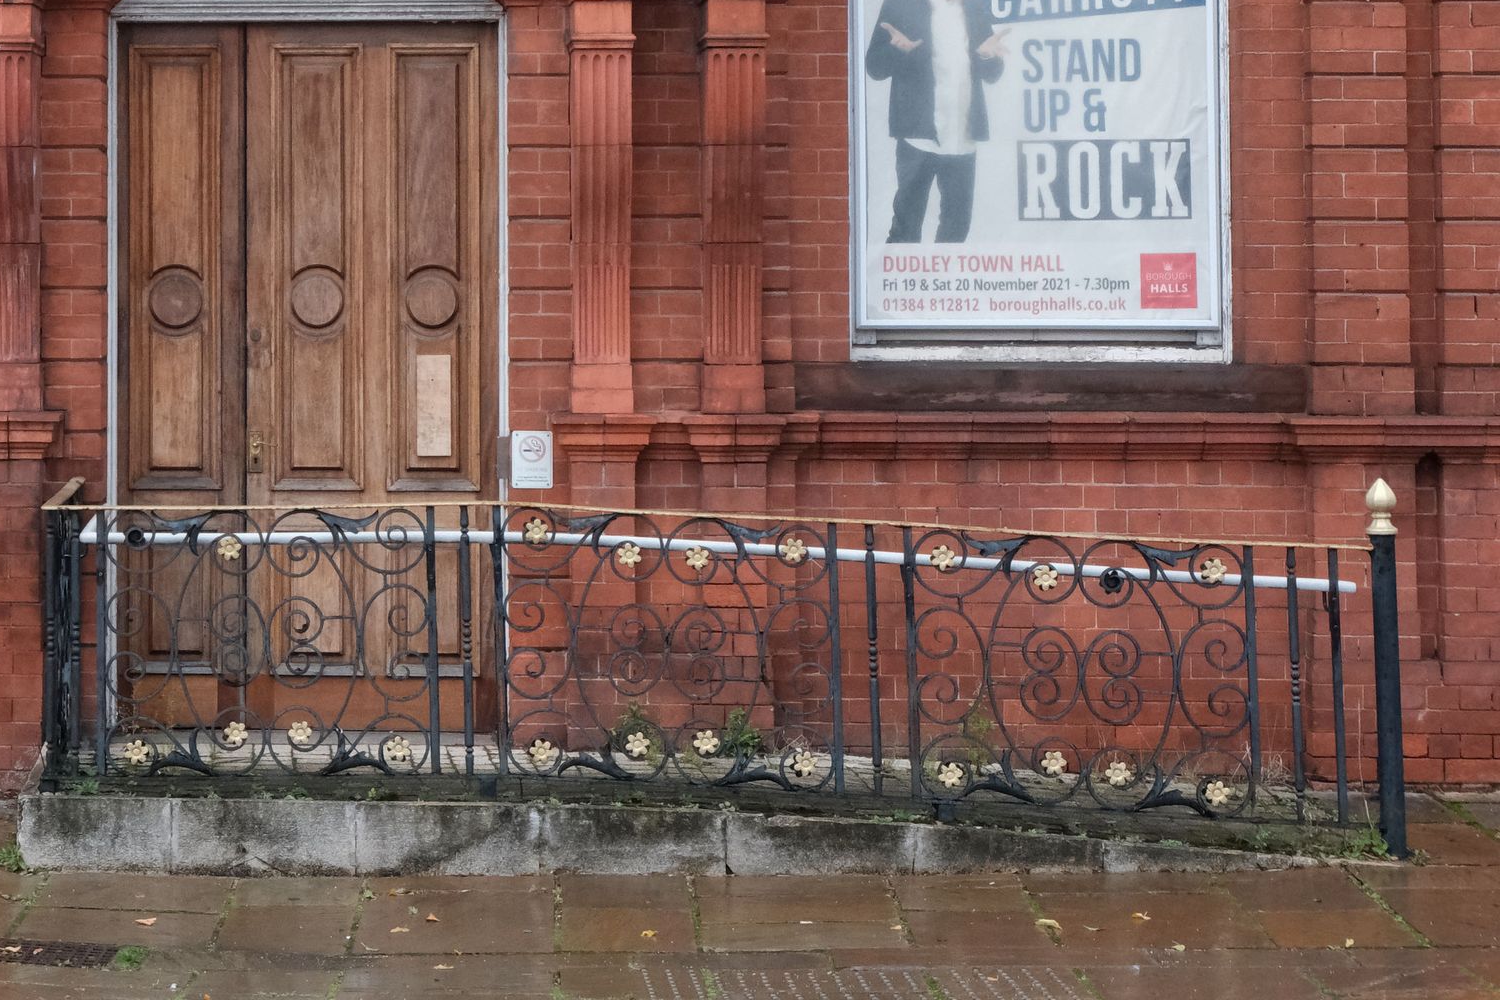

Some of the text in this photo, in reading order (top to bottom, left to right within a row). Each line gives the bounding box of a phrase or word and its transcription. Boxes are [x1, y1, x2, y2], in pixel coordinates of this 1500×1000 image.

[1022, 38, 1142, 83] STAND
[1023, 88, 1107, 133] UP &
[1021, 140, 1189, 220] ROCK
[882, 255, 1065, 273] DUDLEY TOWN HALL
[882, 278, 898, 292] Fri
[901, 279, 916, 292] 19
[919, 278, 929, 292] &
[932, 278, 951, 292] Sat
[955, 278, 970, 291] 20
[973, 277, 1038, 291] November
[1042, 278, 1071, 291] 2021
[1083, 277, 1130, 294] 7.30pm
[1145, 272, 1192, 281] BOROUGH
[1150, 283, 1188, 294] HALLS
[882, 297, 1127, 315] 01384 812812 boroughhalls.co.uk
